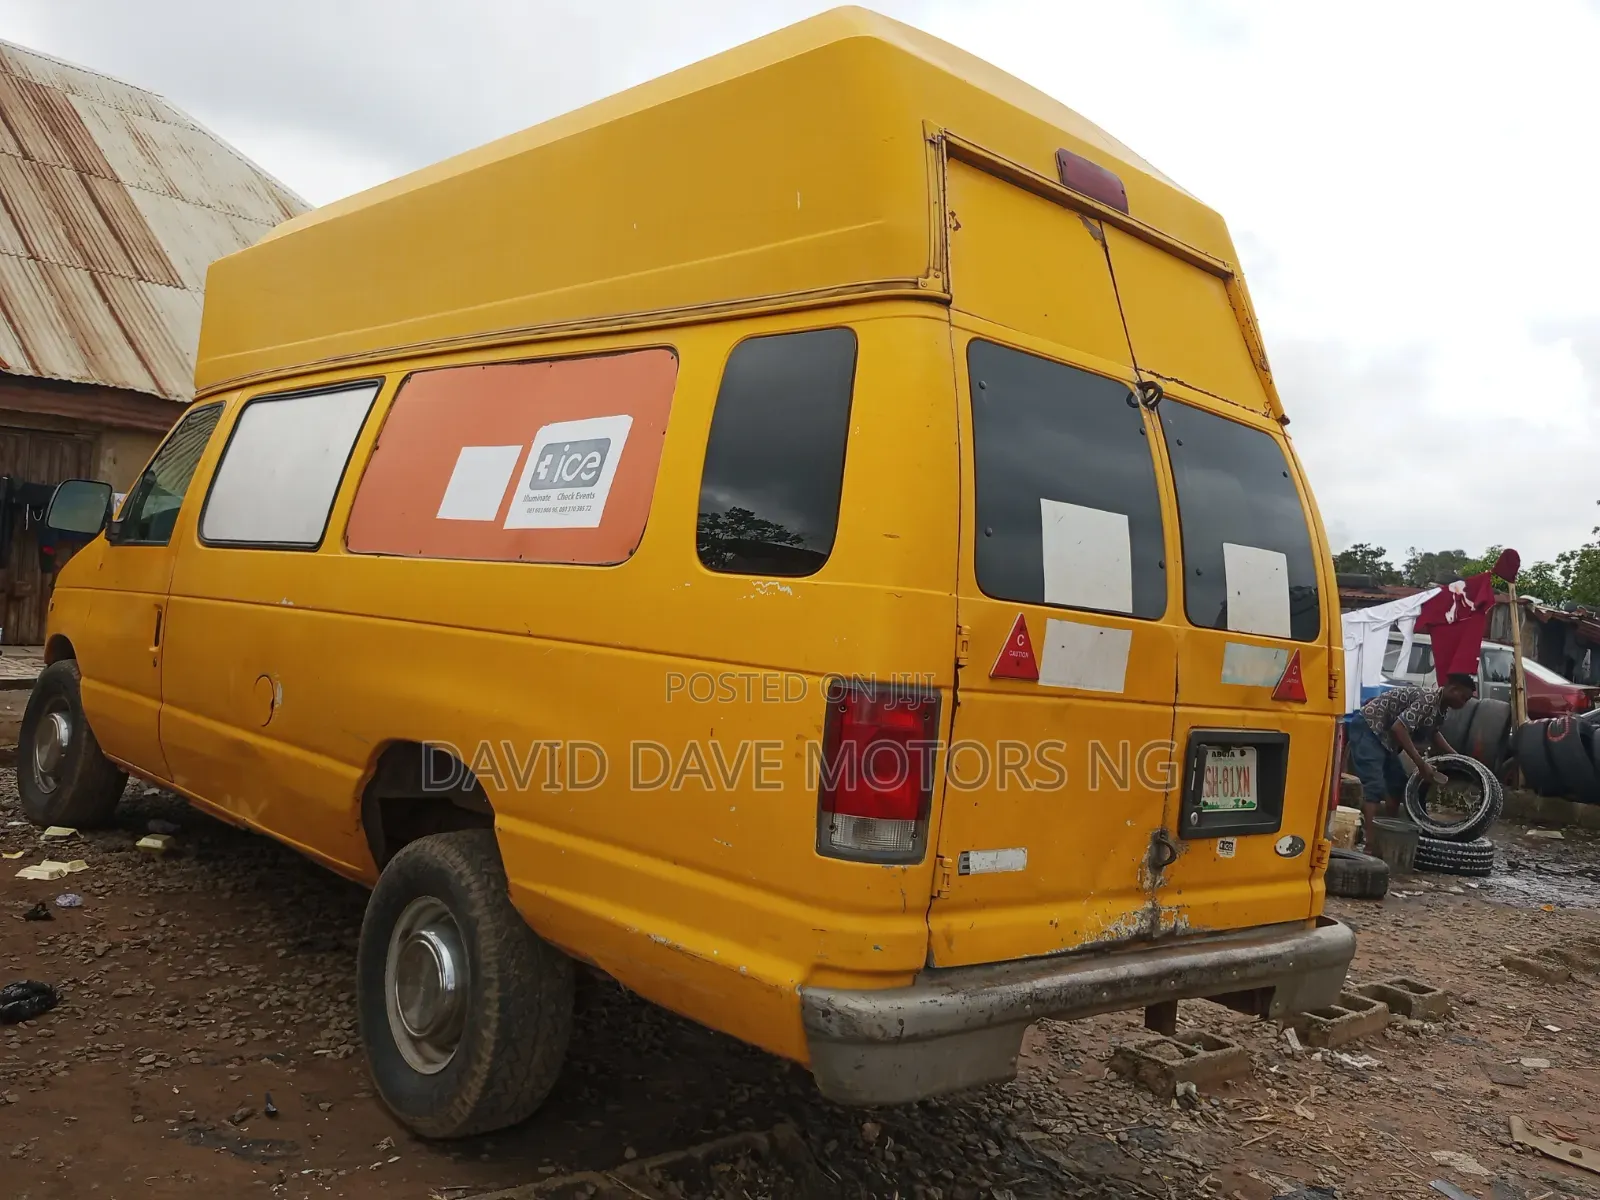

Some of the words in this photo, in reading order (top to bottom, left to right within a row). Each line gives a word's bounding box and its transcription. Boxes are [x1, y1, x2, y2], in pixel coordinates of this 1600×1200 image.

[556, 492, 575, 501] Check
[575, 491, 596, 500] Events
[1016, 633, 1025, 647] C
[1008, 650, 1029, 658] CAUTION
